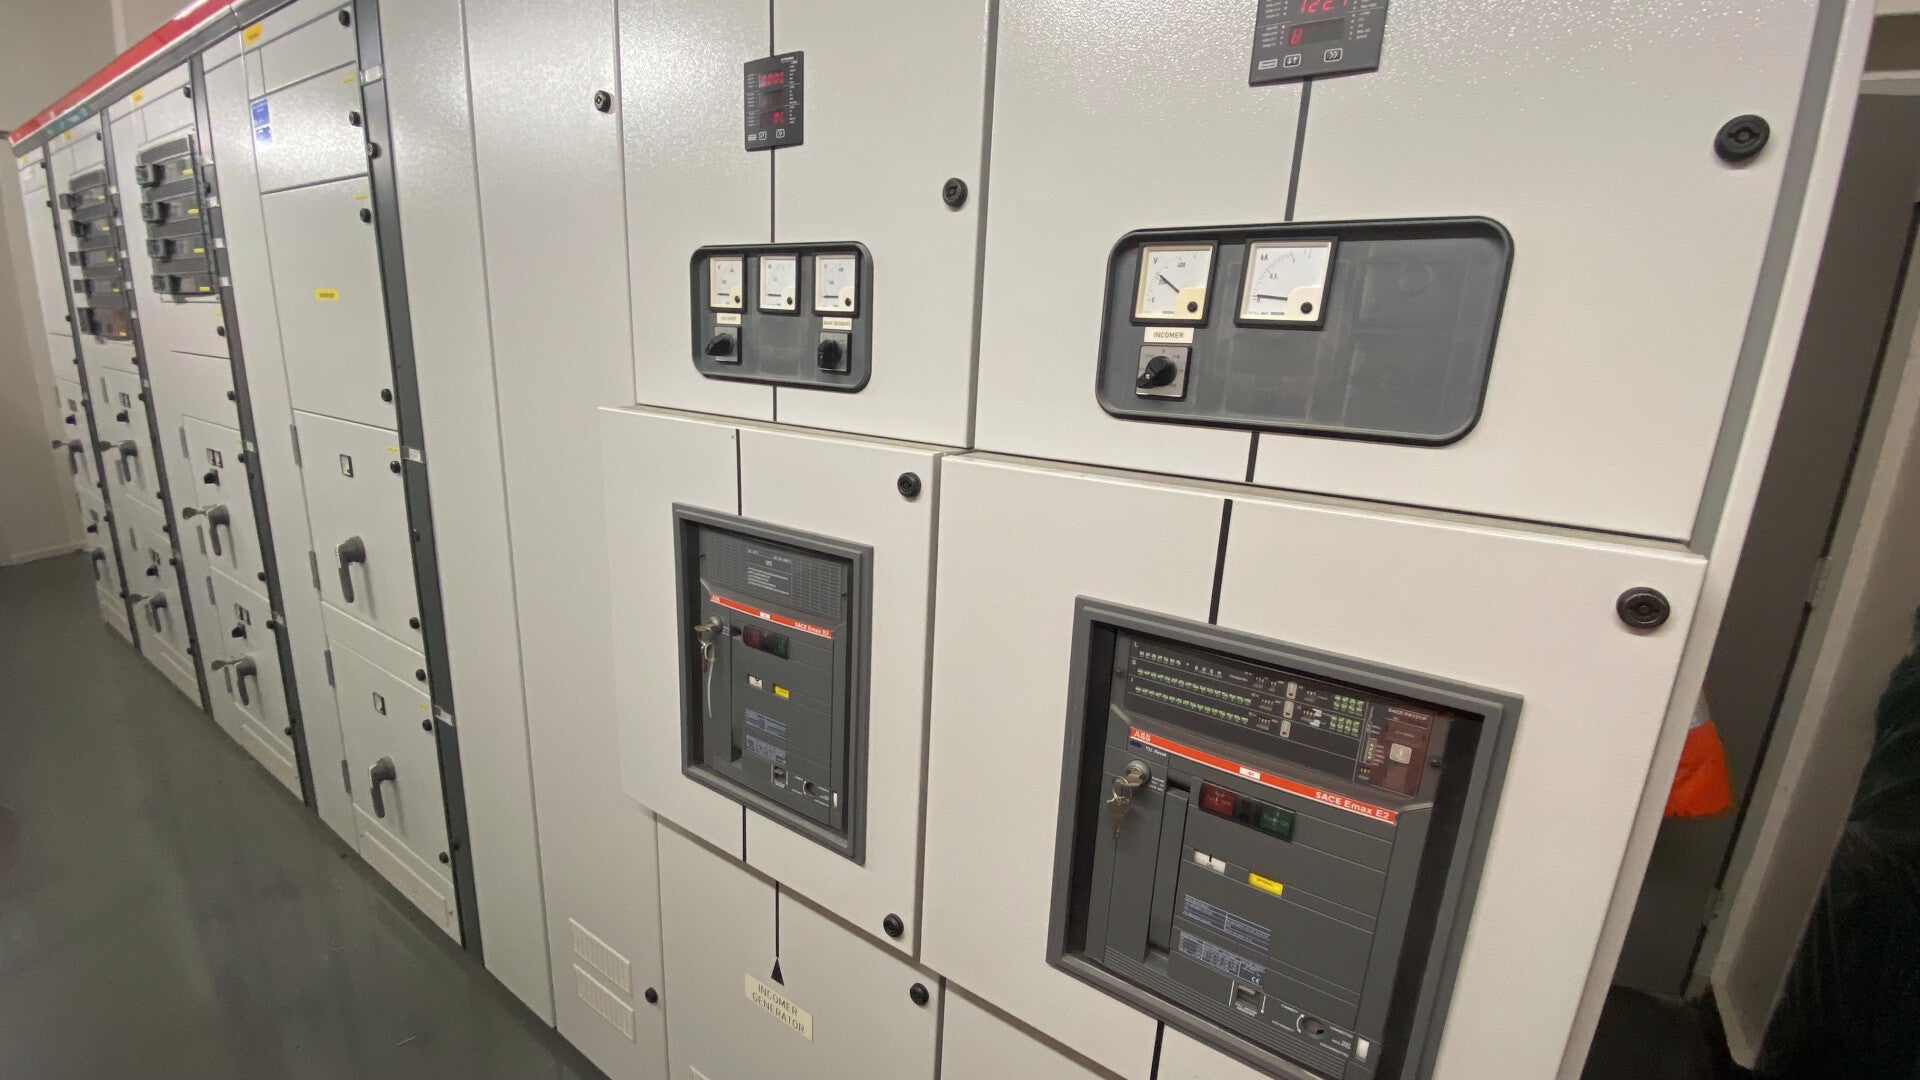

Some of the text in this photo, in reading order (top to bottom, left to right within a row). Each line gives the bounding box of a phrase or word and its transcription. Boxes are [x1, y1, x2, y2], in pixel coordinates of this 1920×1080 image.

[1133, 730, 1151, 742] ABB
[1315, 791, 1390, 820] SACE Emax E2
[752, 992, 805, 1033] GENERATOR
[758, 983, 798, 1016] INCOMER
